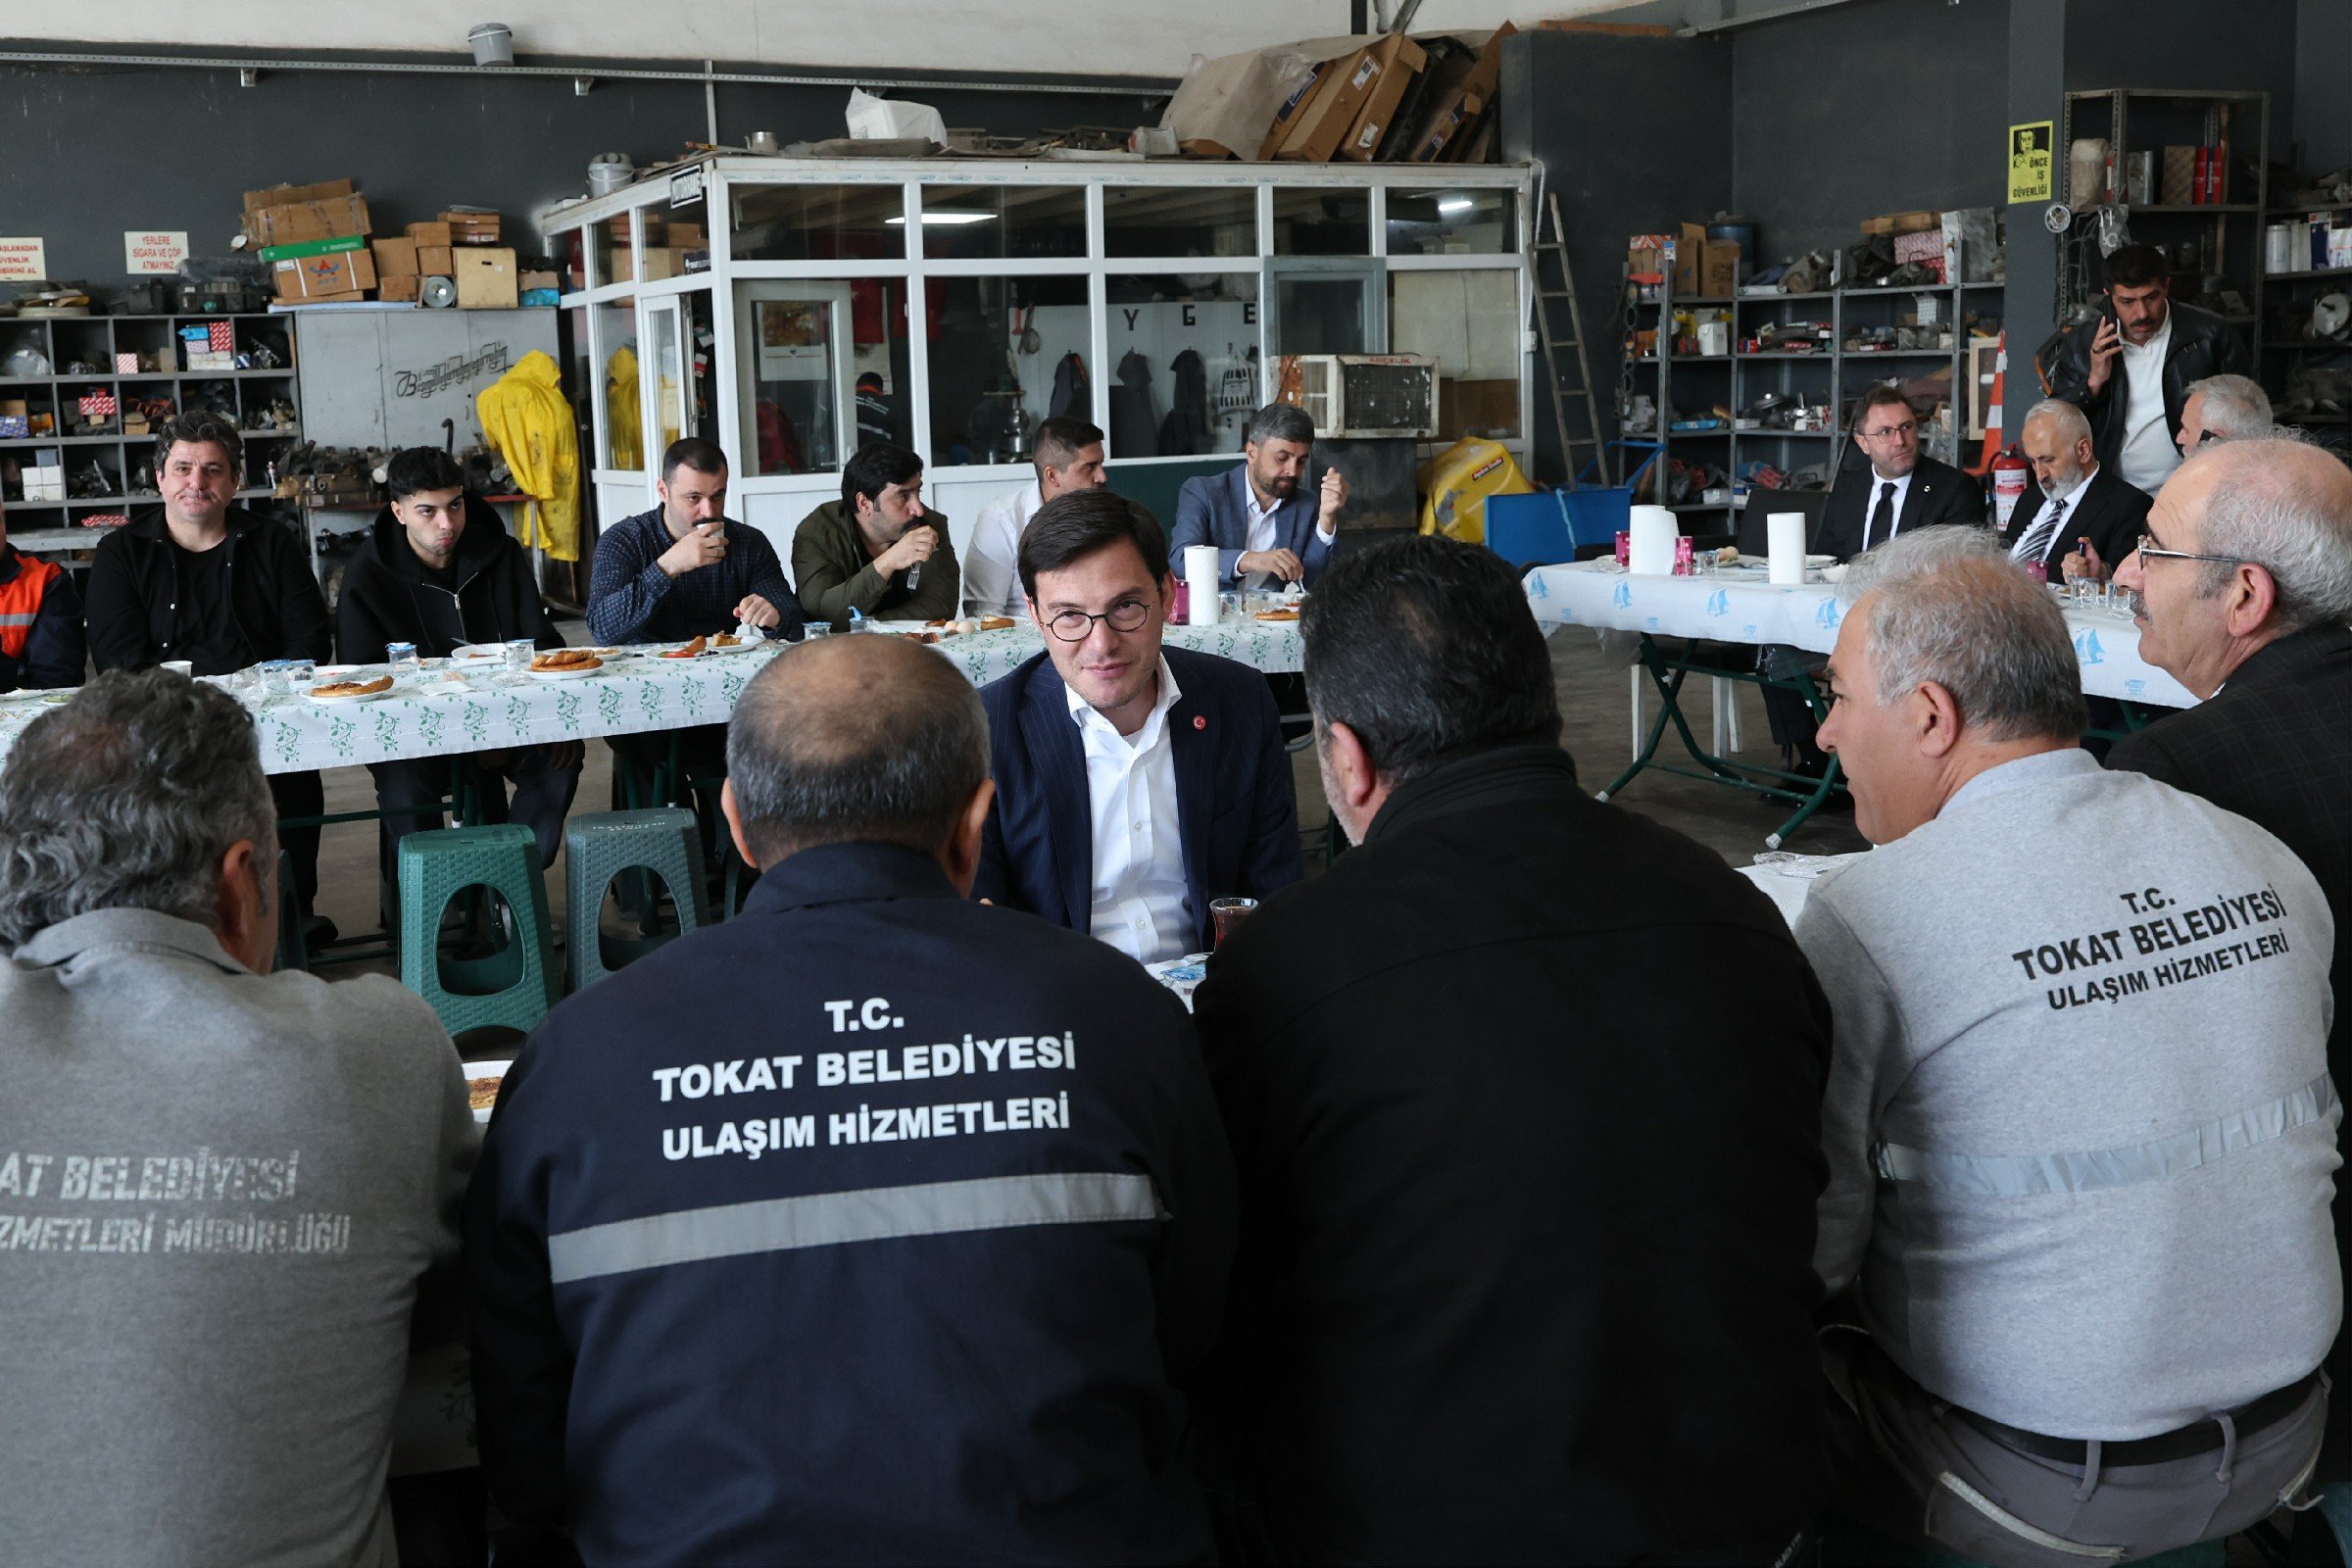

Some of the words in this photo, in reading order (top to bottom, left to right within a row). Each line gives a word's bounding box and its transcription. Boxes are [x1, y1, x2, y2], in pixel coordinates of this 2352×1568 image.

[2030, 157, 2048, 168] ÖNCE
[2037, 170, 2044, 181] İŞ
[2012, 184, 2047, 198] GÜVENLİĞİ
[141, 235, 171, 245] YERLERE
[159, 248, 167, 258] VE
[141, 261, 174, 270] ATMAYINIZ
[1123, 309, 1140, 331] Y
[1182, 305, 1196, 326] G
[1244, 303, 1256, 324] E
[2120, 887, 2176, 914] T.C.
[2012, 930, 2124, 980] TOKAT
[2130, 882, 2287, 956] BELEDİYESİ
[2047, 970, 2149, 1010] ULAŞIM
[2153, 927, 2289, 987] HİZMETLERİ
[824, 998, 905, 1032] T.C.
[653, 1055, 803, 1102] TOKAT
[816, 1031, 1076, 1086] BELEDİYESİ
[662, 1115, 815, 1159] ULAŞIM
[829, 1091, 1070, 1145] HİZMETLERİ
[60, 1147, 299, 1200] BELEDİYESİ
